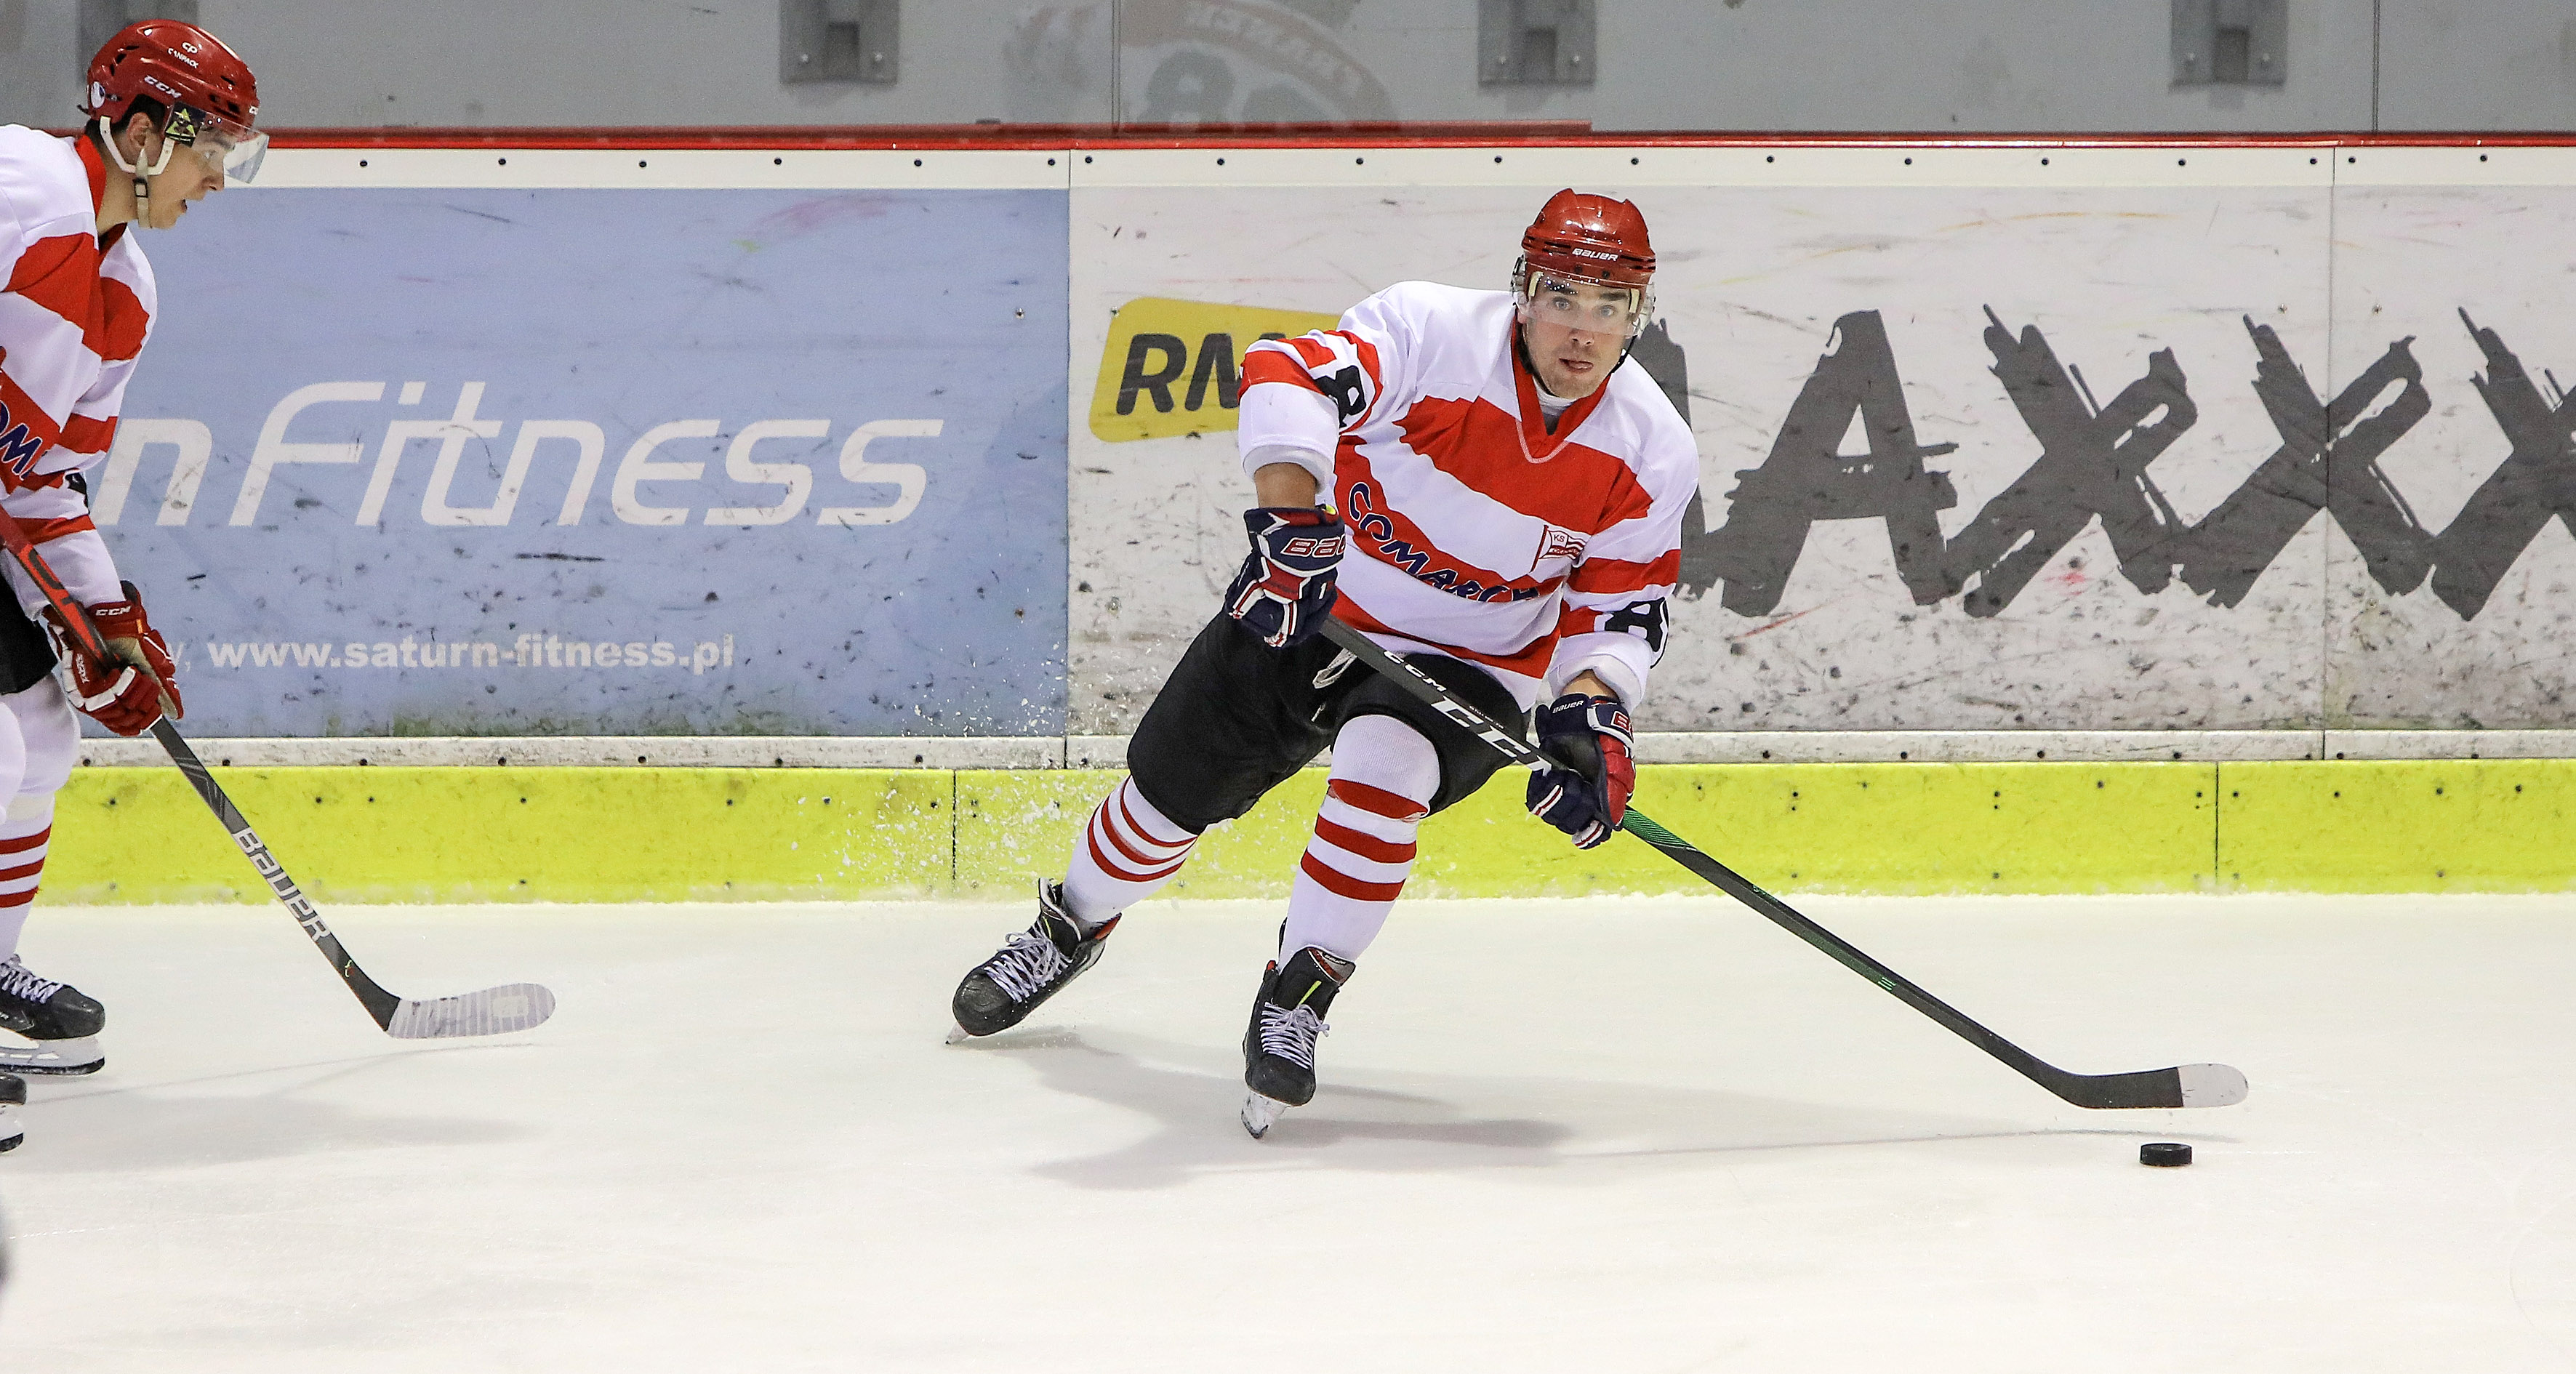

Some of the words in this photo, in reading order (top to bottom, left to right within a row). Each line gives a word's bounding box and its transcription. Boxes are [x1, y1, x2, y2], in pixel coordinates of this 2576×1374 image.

[143, 75, 182, 99] CCM
[1116, 332, 1287, 416] RM
[228, 381, 944, 526] Fitness
[1553, 534, 1565, 543] KS
[95, 605, 132, 616] CCM
[206, 633, 734, 675] www.saturn-fitness.pl
[1384, 649, 1448, 692] CCM
